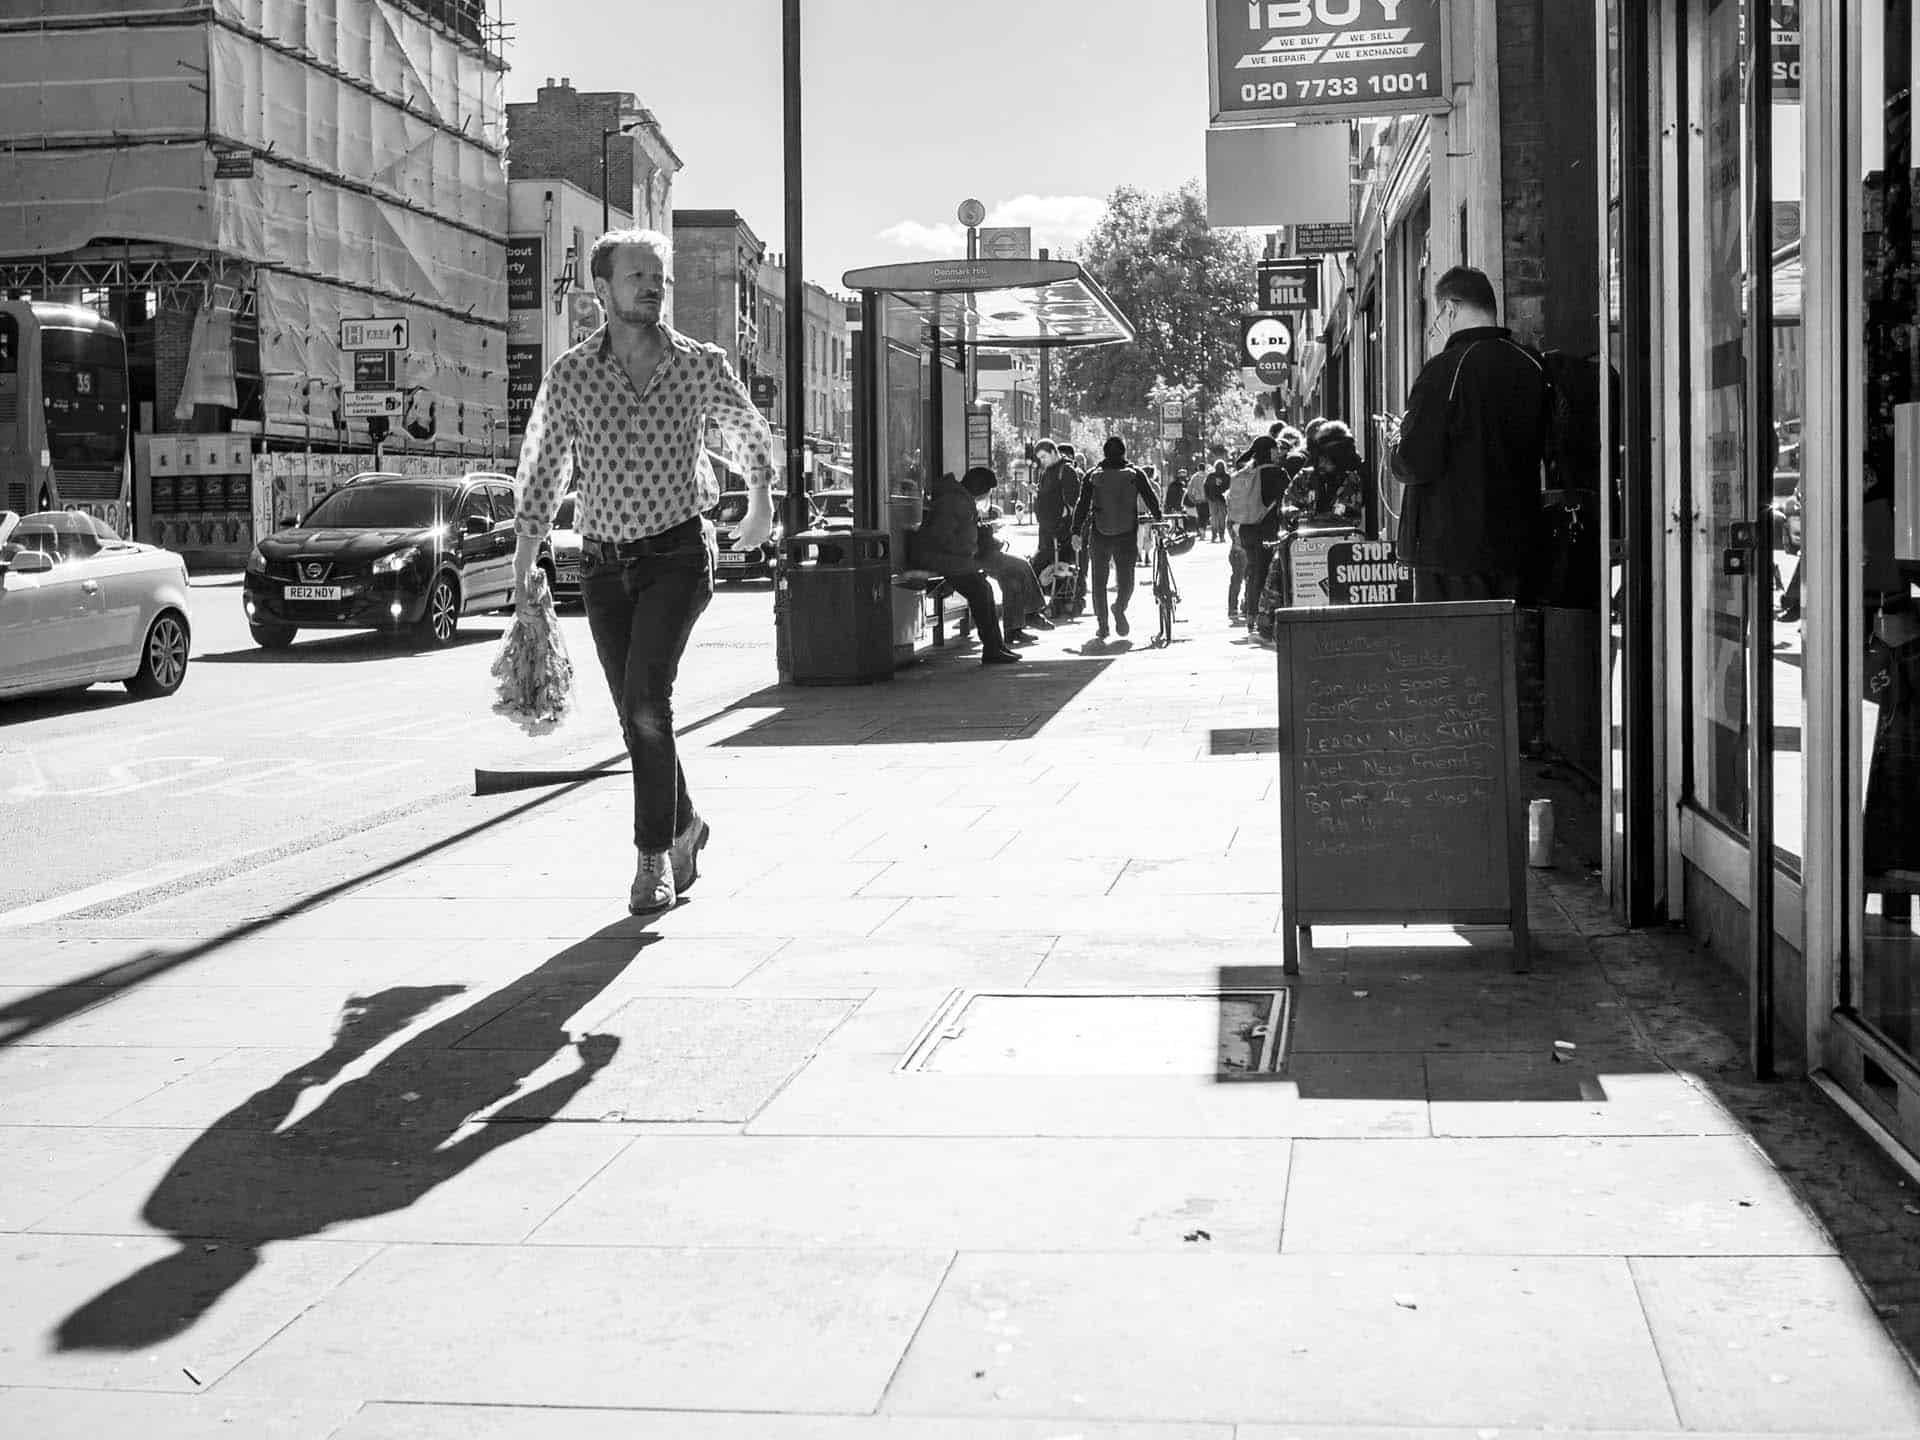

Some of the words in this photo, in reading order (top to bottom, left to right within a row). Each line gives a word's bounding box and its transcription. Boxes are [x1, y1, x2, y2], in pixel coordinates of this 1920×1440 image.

[1350, 33, 1365, 41] WE
[1370, 31, 1394, 40] SELL
[1280, 39, 1295, 47] WE
[1300, 37, 1320, 46] BUY
[1335, 50, 1351, 58] WE
[1356, 47, 1409, 57] EXCHANGE
[1250, 56, 1266, 64] WE
[1271, 54, 1306, 63] REPAIR
[1241, 82, 1288, 101] 020
[1296, 77, 1358, 98] 7733
[1367, 72, 1428, 94] 1001
[1270, 287, 1306, 304] HILL
[1259, 362, 1288, 370] COSTA
[1351, 543, 1392, 561] STOP
[1336, 563, 1409, 583] SMOKING
[290, 587, 313, 598] RE12
[1349, 584, 1398, 603] START
